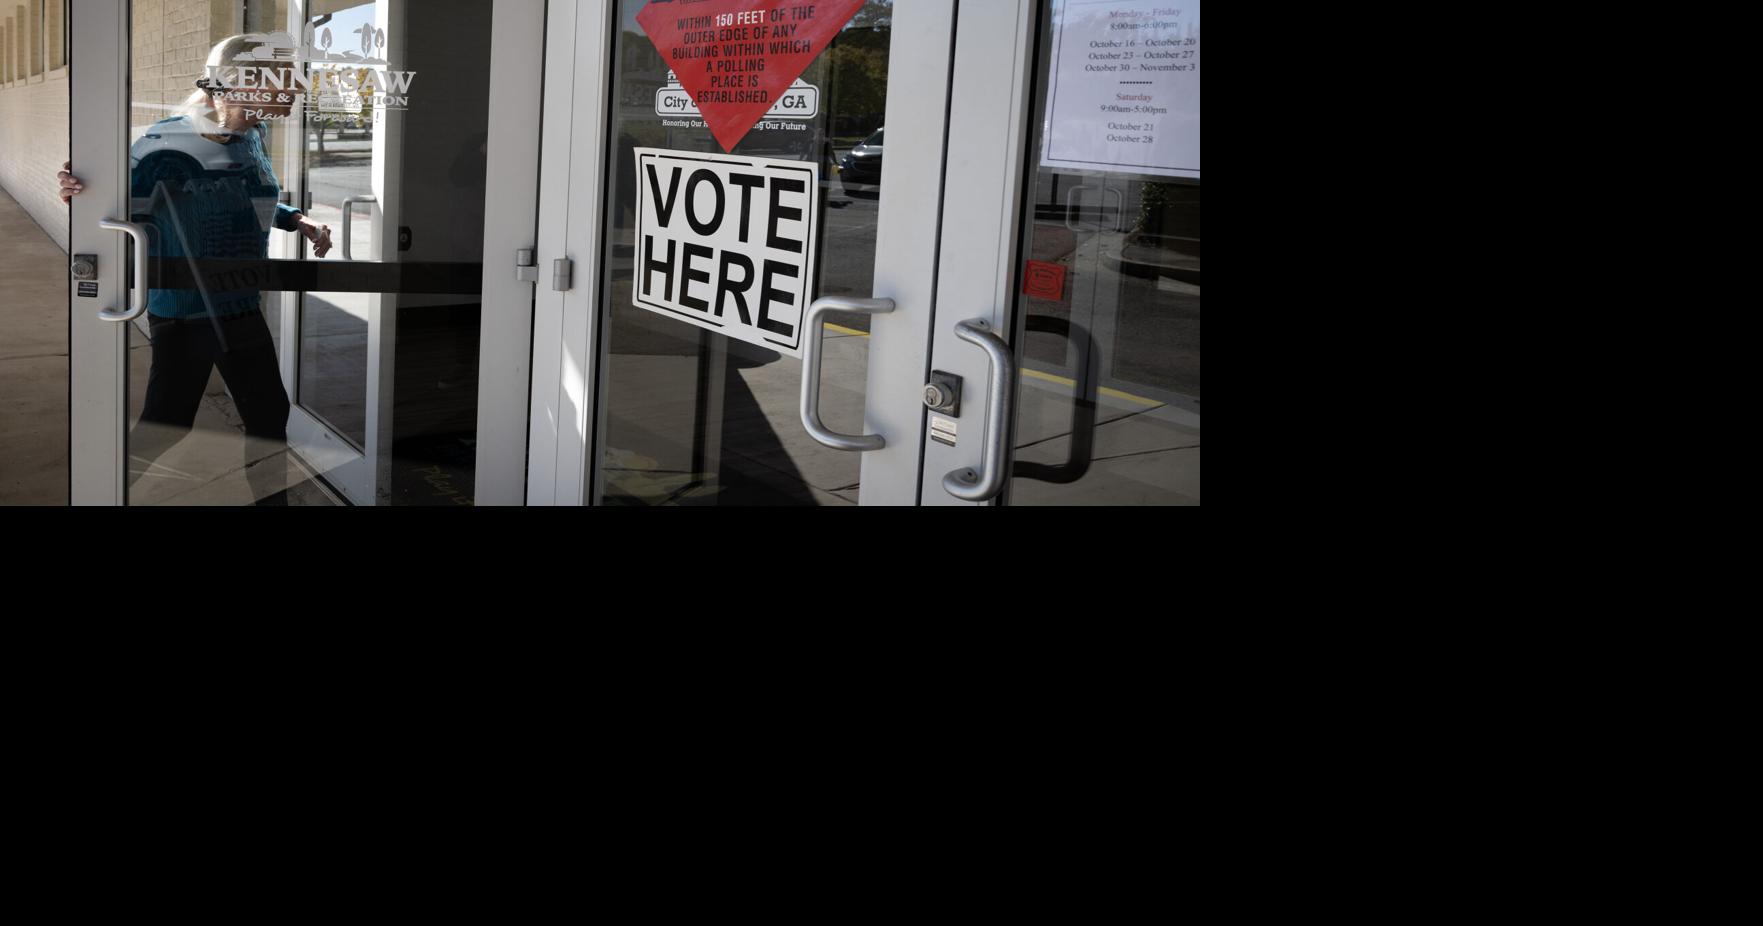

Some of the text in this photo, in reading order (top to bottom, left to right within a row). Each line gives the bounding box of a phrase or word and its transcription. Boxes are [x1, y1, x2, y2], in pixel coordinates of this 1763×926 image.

[677, 5, 816, 30] WITHIN 150 FEET OF THE
[1109, 9, 1143, 18] Monday
[1152, 8, 1182, 17] Friday
[684, 24, 797, 45] OUTER EDGE OF ANY
[672, 39, 811, 59] BUILDING WITHIN WHICH
[1089, 40, 1121, 48] October
[1145, 38, 1181, 47] October
[1183, 38, 1197, 46] 20
[1088, 52, 1121, 60] October
[1144, 51, 1180, 59] October
[1182, 50, 1195, 58] 27
[706, 59, 765, 73] A POLLING
[1085, 64, 1117, 72] October
[1140, 63, 1186, 71] November
[1189, 63, 1195, 71] 3
[206, 65, 417, 94] KENNESAW
[711, 75, 758, 88] PLACE IS
[213, 91, 272, 102] PARKS
[276, 92, 290, 103] &
[664, 96, 688, 110] City
[782, 95, 807, 109] GA
[697, 91, 773, 104] ESTABLISHED.
[1116, 93, 1152, 103] Saturday
[1100, 104, 1167, 116] 9:00am-5:00pm
[662, 119, 690, 129] Honoring
[691, 120, 703, 128] Our
[781, 123, 807, 131] Future
[1108, 122, 1154, 131] October 21
[1106, 134, 1154, 144] October 28
[646, 164, 805, 254] VOTE
[643, 235, 799, 338] HERE
